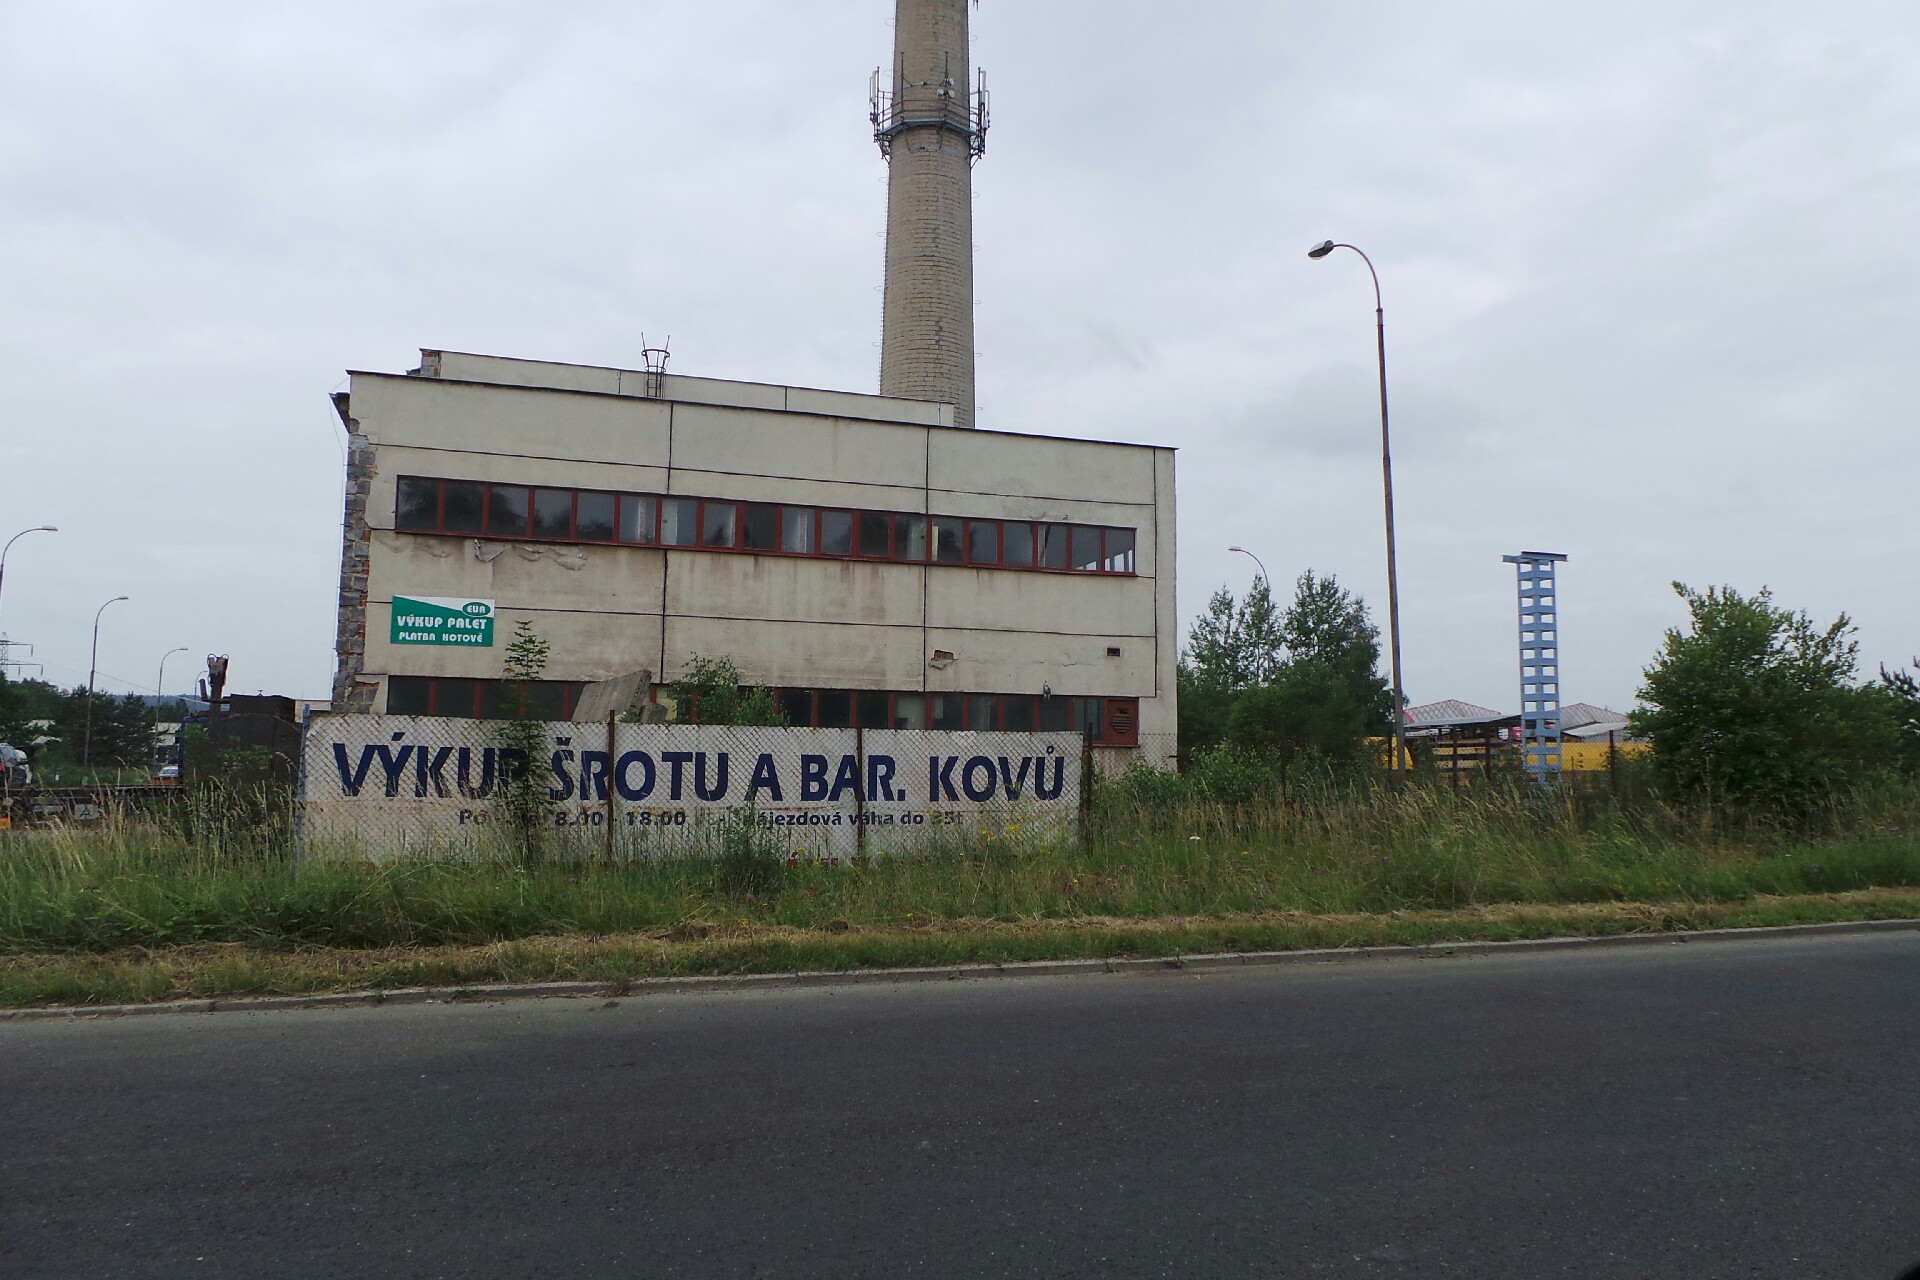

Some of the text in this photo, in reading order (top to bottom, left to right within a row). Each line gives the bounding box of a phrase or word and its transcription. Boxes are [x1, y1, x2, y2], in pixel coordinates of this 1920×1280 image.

[466, 605, 486, 614] EUR
[397, 614, 487, 630] VÝKUP PALET
[399, 632, 436, 641] PLATBA
[549, 736, 729, 802] ŠROTU
[744, 753, 783, 802] A
[800, 753, 906, 802] BAR.
[929, 746, 1065, 802] KOVŮ
[626, 811, 686, 826] 18.00
[745, 811, 842, 830] ájezdová
[900, 811, 924, 825] do
